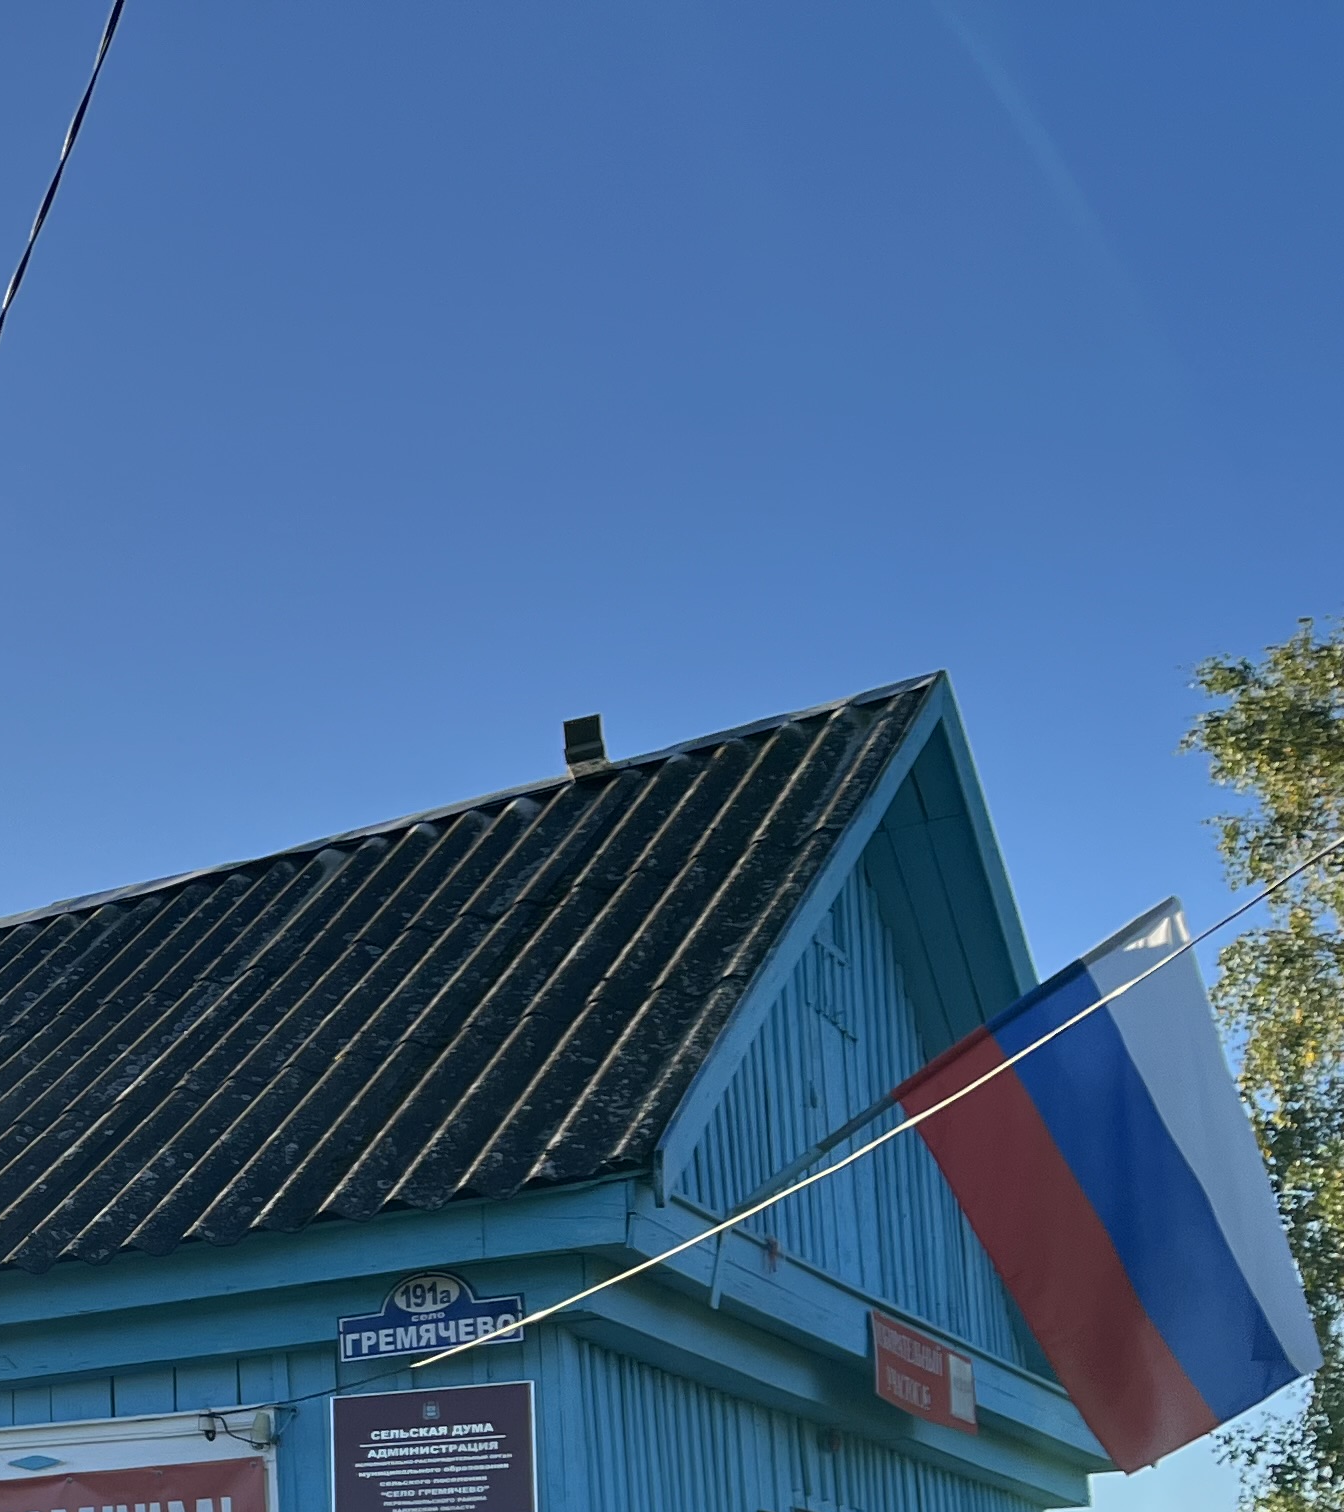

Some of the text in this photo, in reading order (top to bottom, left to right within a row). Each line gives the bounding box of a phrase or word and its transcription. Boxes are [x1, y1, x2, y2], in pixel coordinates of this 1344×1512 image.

[399, 1281, 452, 1309] 191а
[411, 1311, 445, 1322] село
[345, 1314, 516, 1356] ГРЕМЯЧЕВО
[370, 1422, 495, 1441] СЕЛЬСКАЯ ДУМА
[367, 1441, 499, 1459] АДМИНИСТРАЦИЯ
[379, 1478, 432, 1487] сельского
